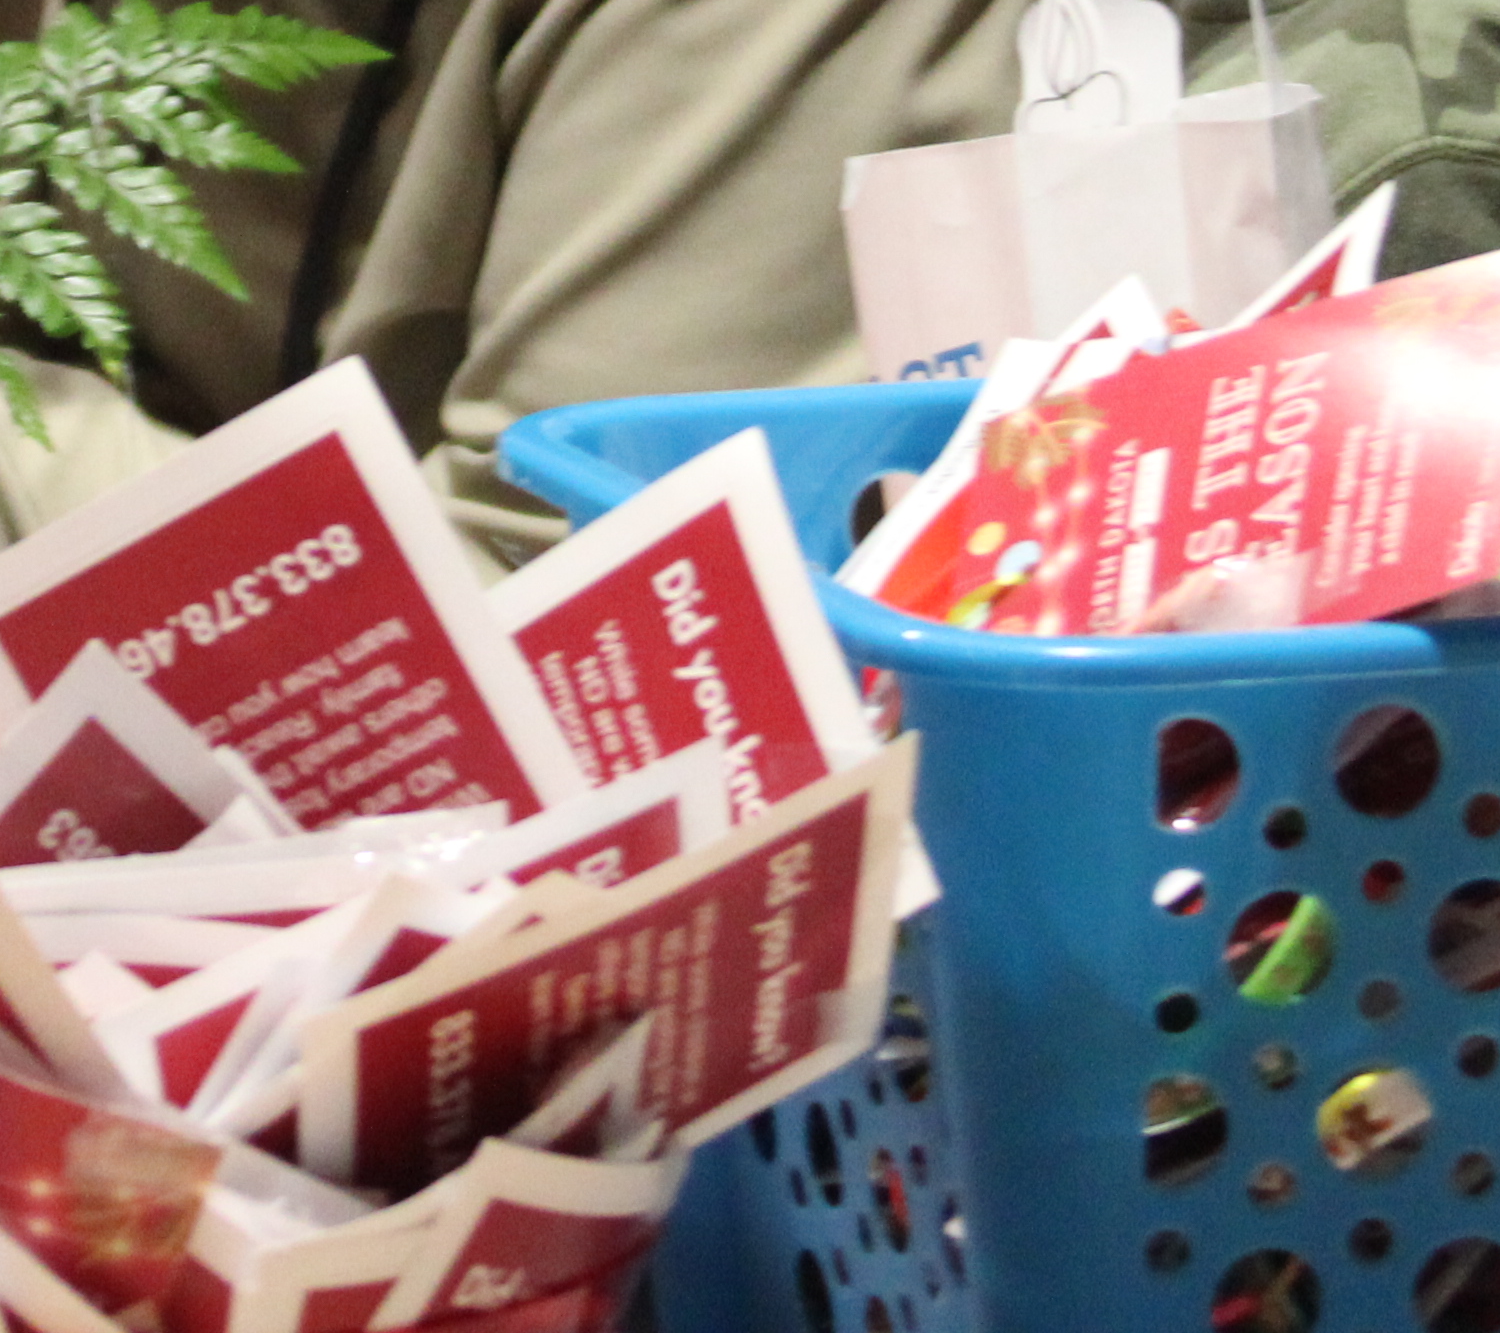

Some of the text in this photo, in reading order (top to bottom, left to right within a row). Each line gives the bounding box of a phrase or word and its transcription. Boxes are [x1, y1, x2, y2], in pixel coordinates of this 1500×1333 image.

[1186, 355, 1270, 516] THE
[642, 553, 725, 650] Did
[667, 644, 750, 743] you
